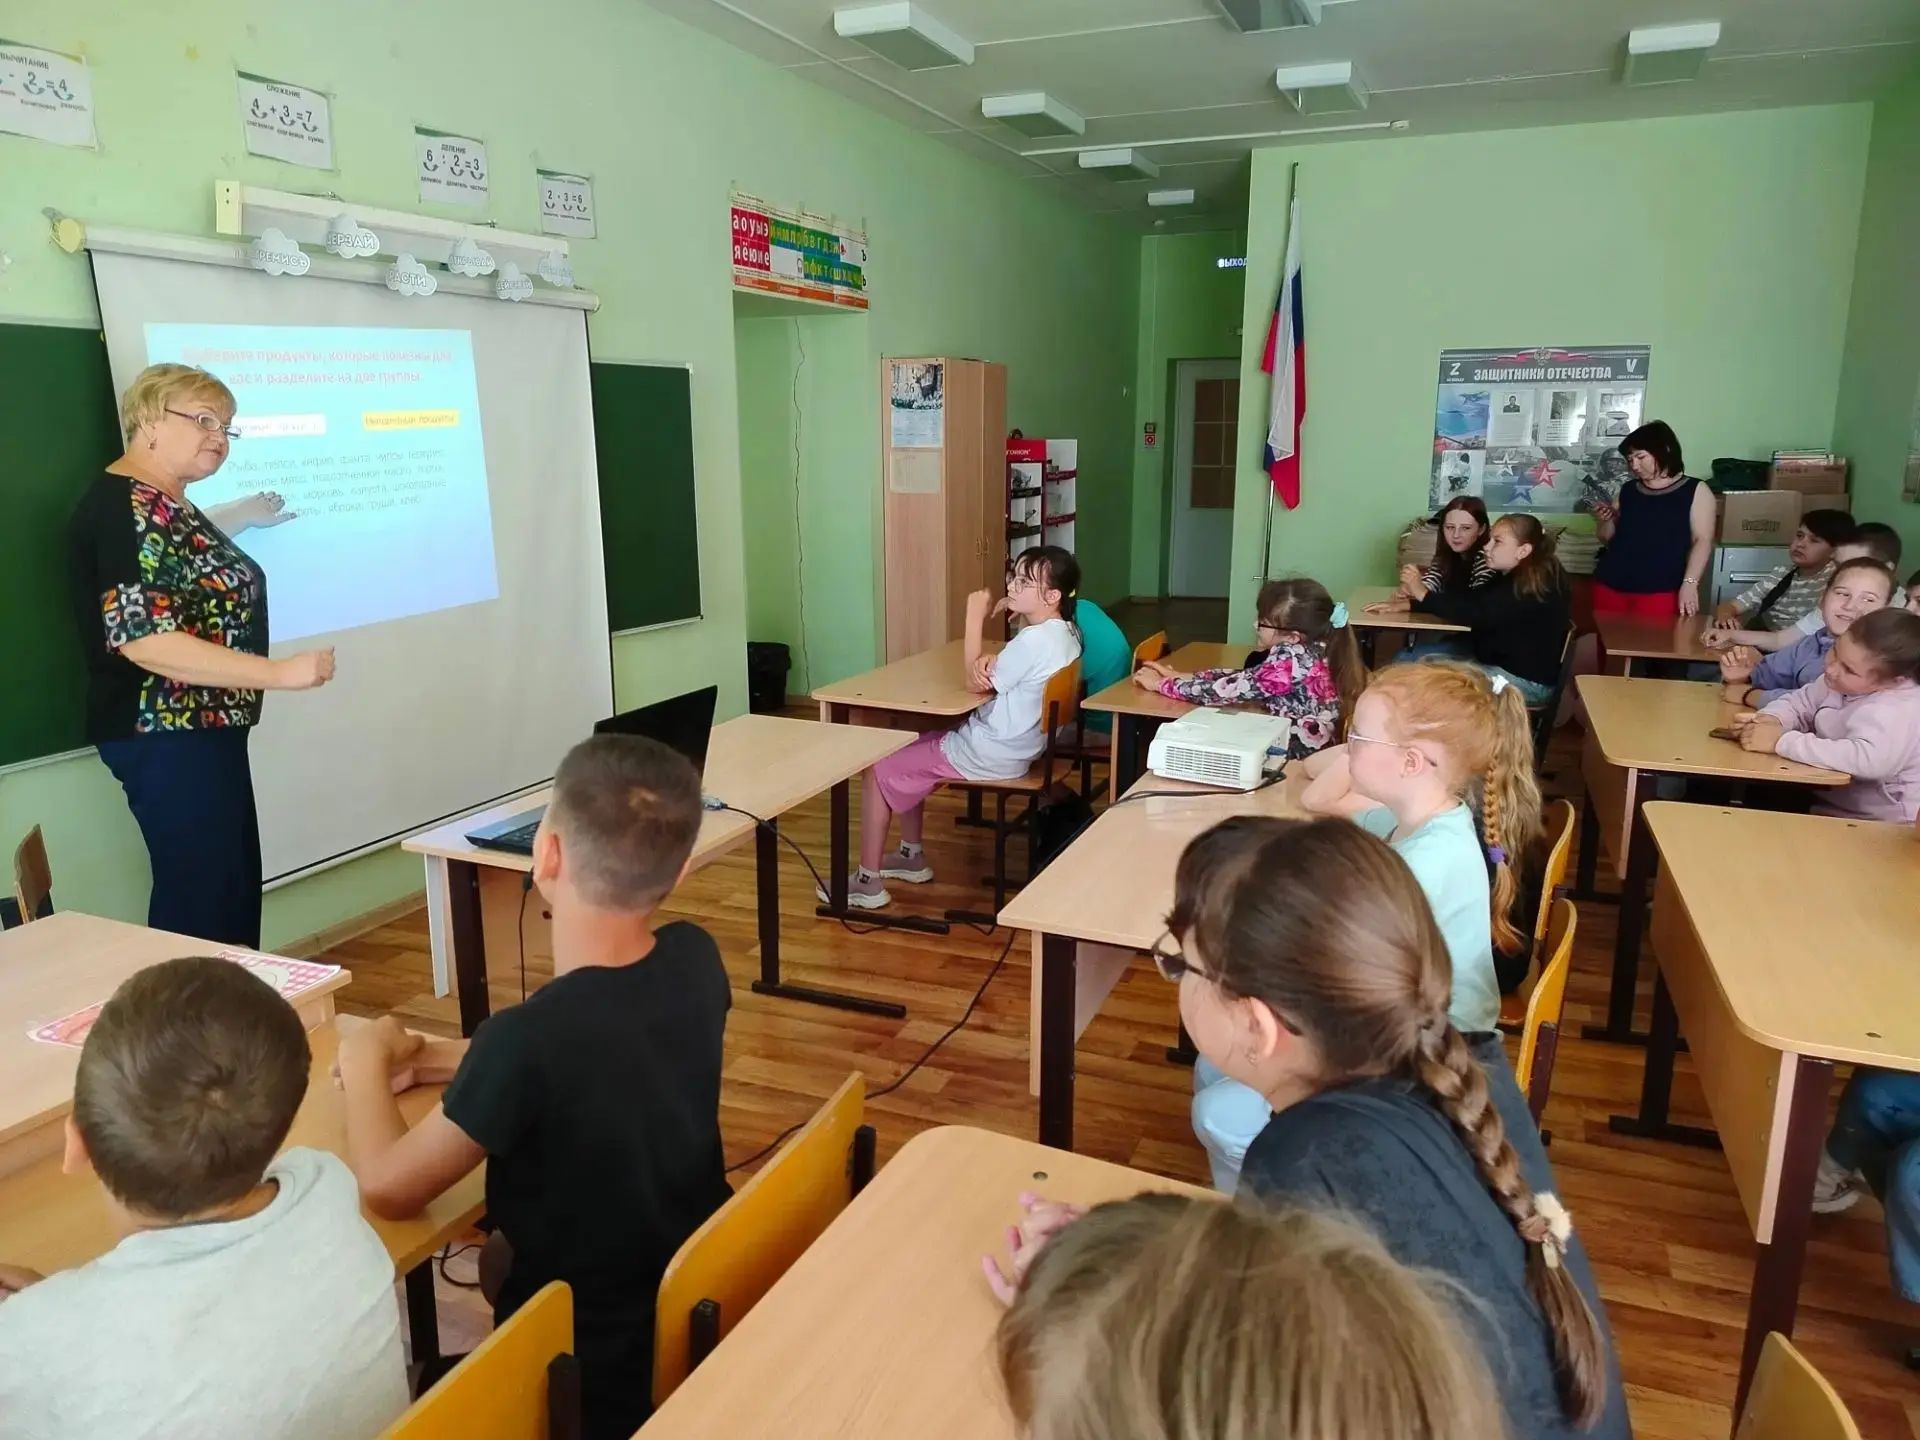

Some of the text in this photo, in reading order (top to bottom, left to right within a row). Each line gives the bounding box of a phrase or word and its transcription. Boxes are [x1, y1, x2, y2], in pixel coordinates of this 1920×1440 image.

[27, 71, 37, 86] 2
[252, 98, 260, 110] 4
[282, 105, 290, 117] 3
[426, 149, 433, 162] 6
[453, 154, 460, 167] 2
[547, 190, 553, 200] 2
[1450, 363, 1461, 375] Z
[1474, 367, 1545, 381] ЗАЩИТНИКИ
[1547, 366, 1612, 380] ОТЕЧЕСТВА
[1626, 359, 1638, 373] V
